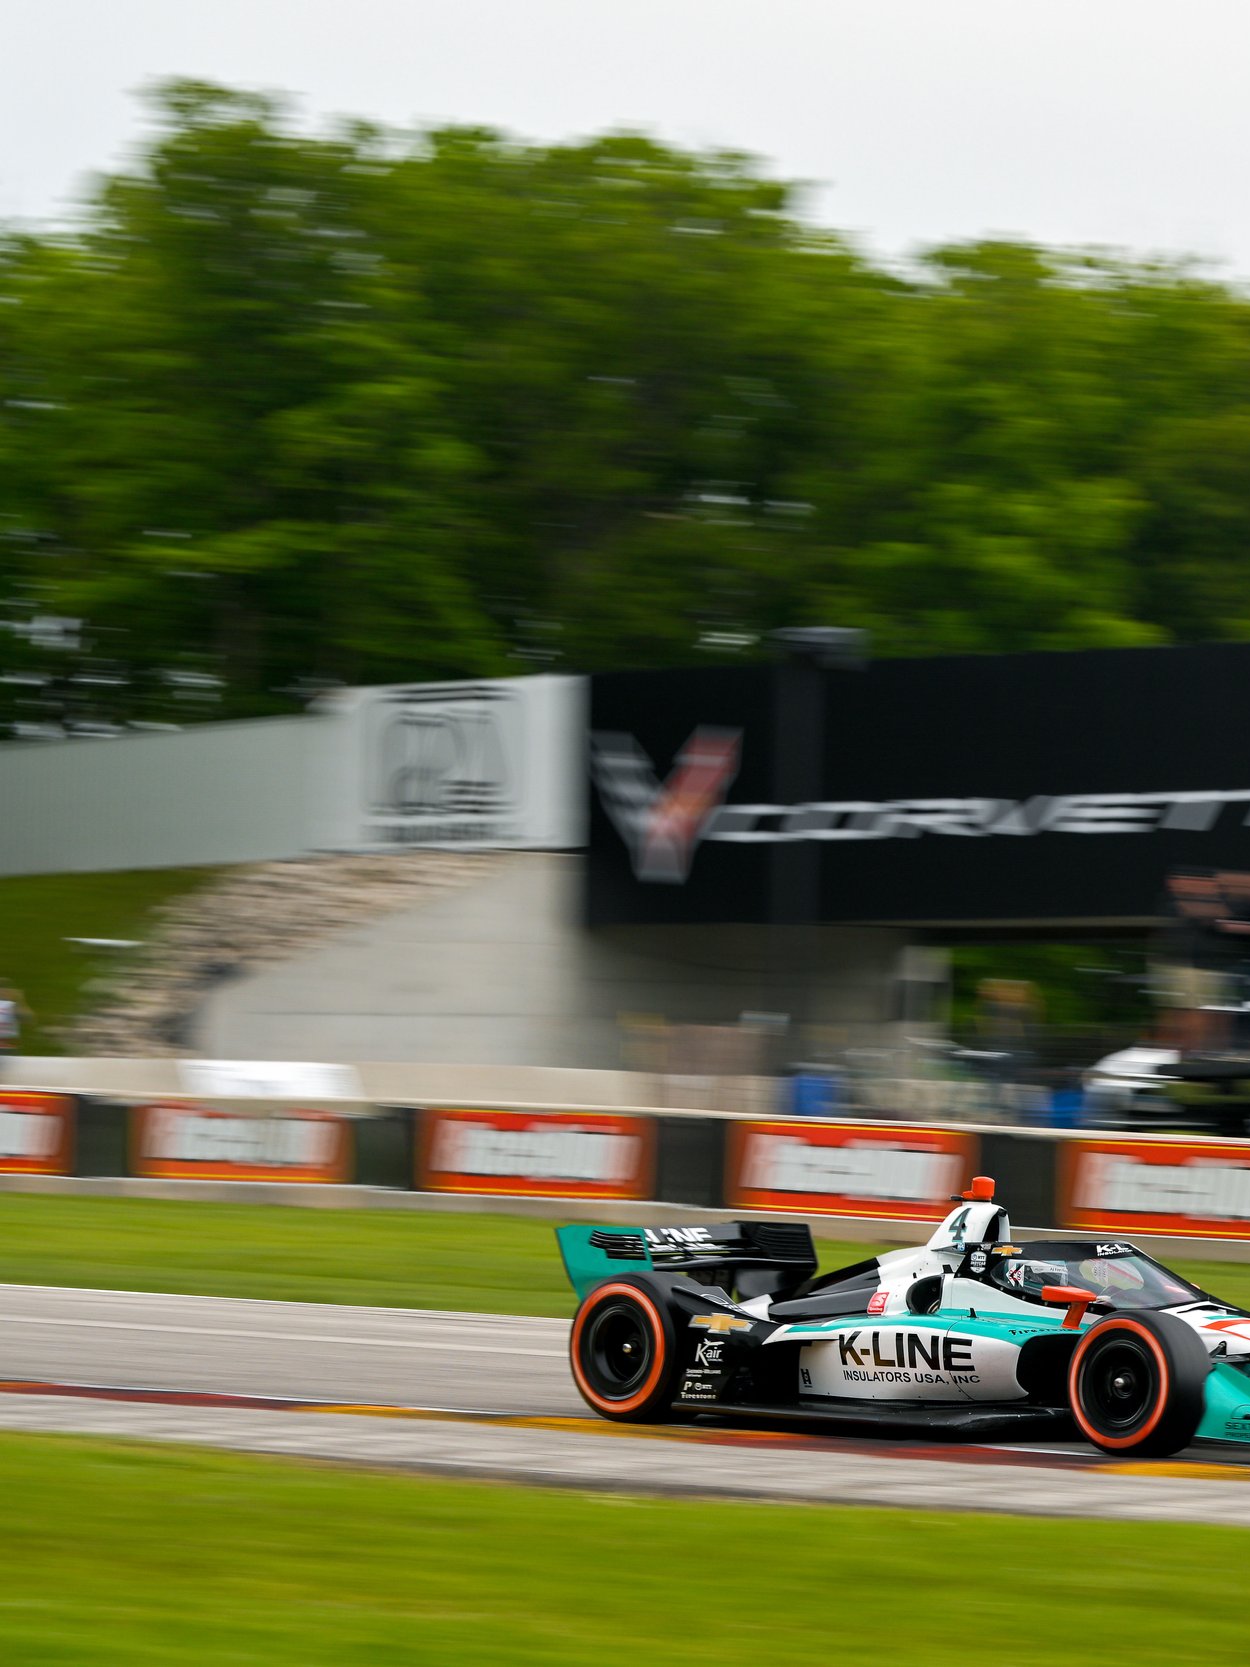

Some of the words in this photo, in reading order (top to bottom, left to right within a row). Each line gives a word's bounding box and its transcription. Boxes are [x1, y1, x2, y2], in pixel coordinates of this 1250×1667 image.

[948, 1207, 972, 1243] 4
[838, 1331, 976, 1372] K-LINE
[843, 1370, 912, 1384] INSULATORS
[680, 1391, 716, 1399] Firestone
